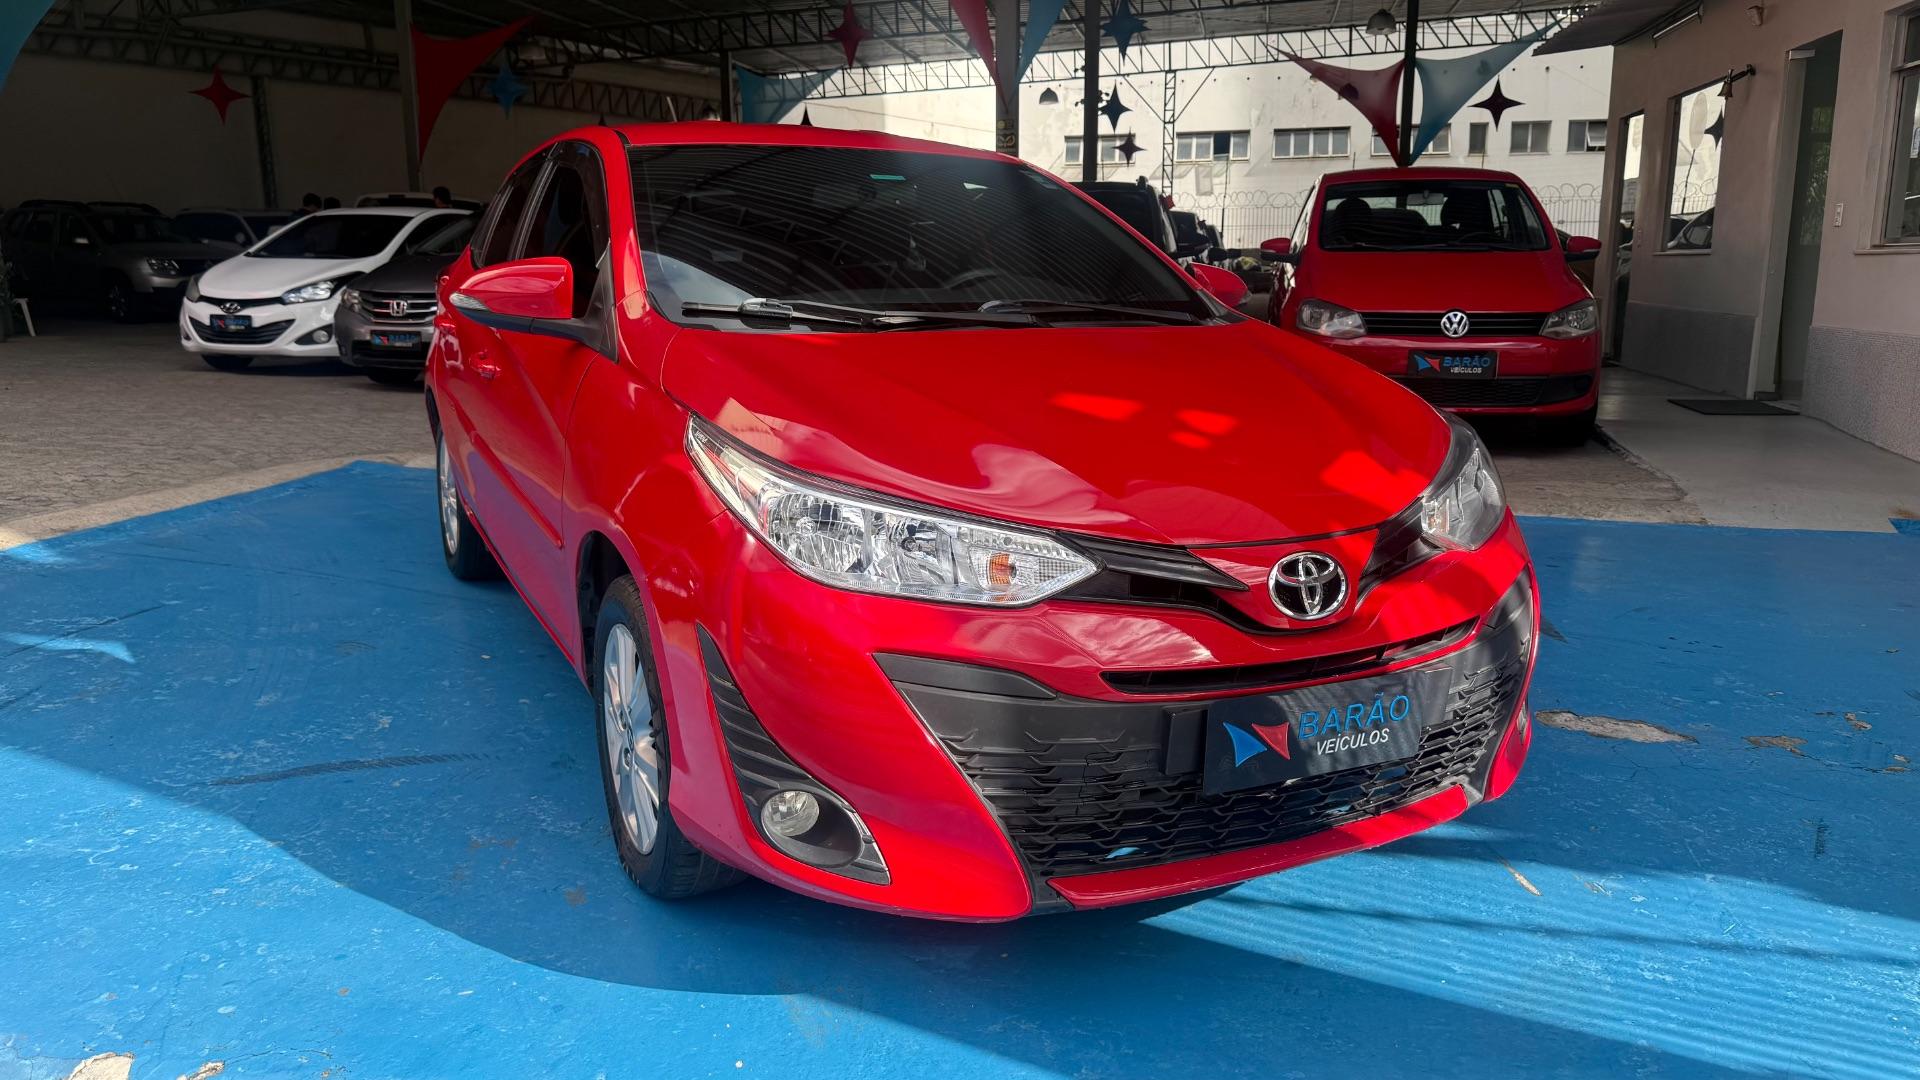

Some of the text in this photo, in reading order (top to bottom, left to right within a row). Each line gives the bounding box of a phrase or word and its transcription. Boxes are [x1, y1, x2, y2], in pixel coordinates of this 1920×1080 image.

[1443, 355, 1491, 367] BARÃO
[1298, 692, 1410, 740] BARÃO
[1316, 727, 1390, 756] VEÍCULOS
